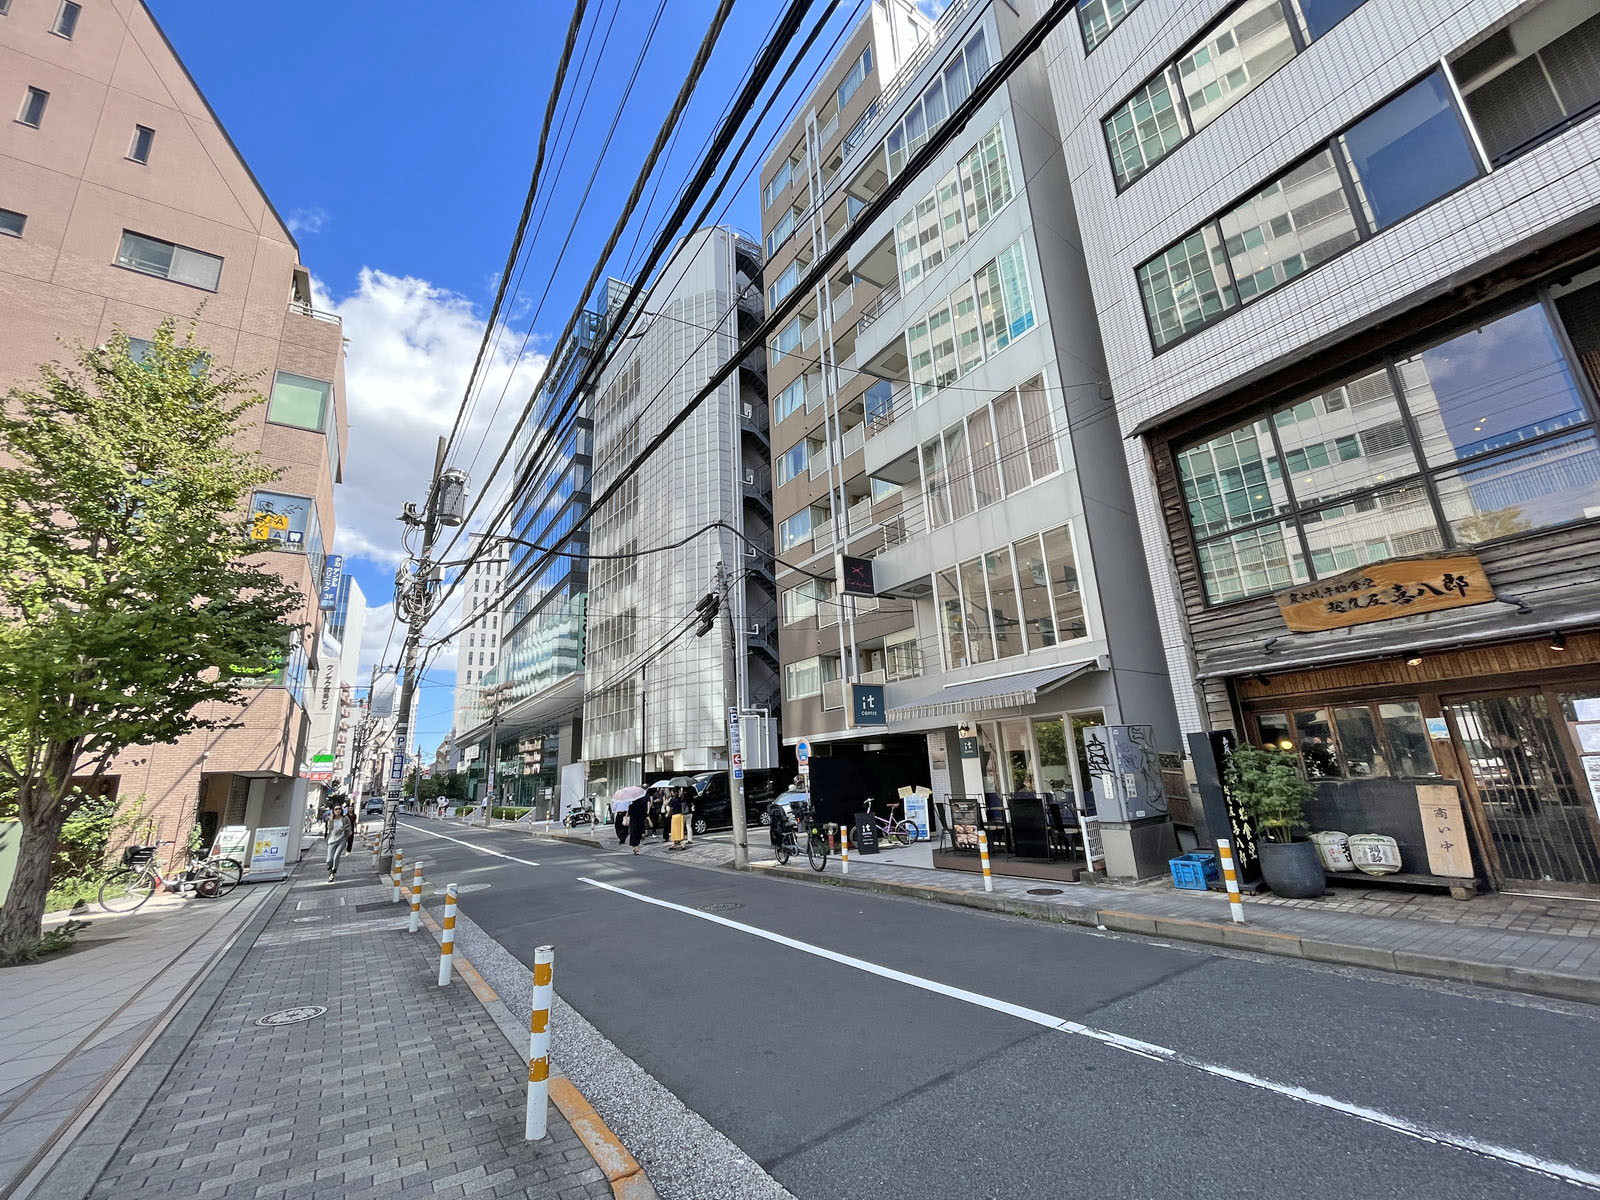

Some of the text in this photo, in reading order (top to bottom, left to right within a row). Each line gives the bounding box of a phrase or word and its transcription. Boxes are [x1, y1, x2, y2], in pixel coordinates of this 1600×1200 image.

[323, 567, 333, 592] クリニック
[330, 556, 342, 588] タカデンタル
[862, 694, 875, 710] it
[730, 713, 738, 723] P
[397, 736, 405, 746] P
[1433, 807, 1455, 853] 商い中
